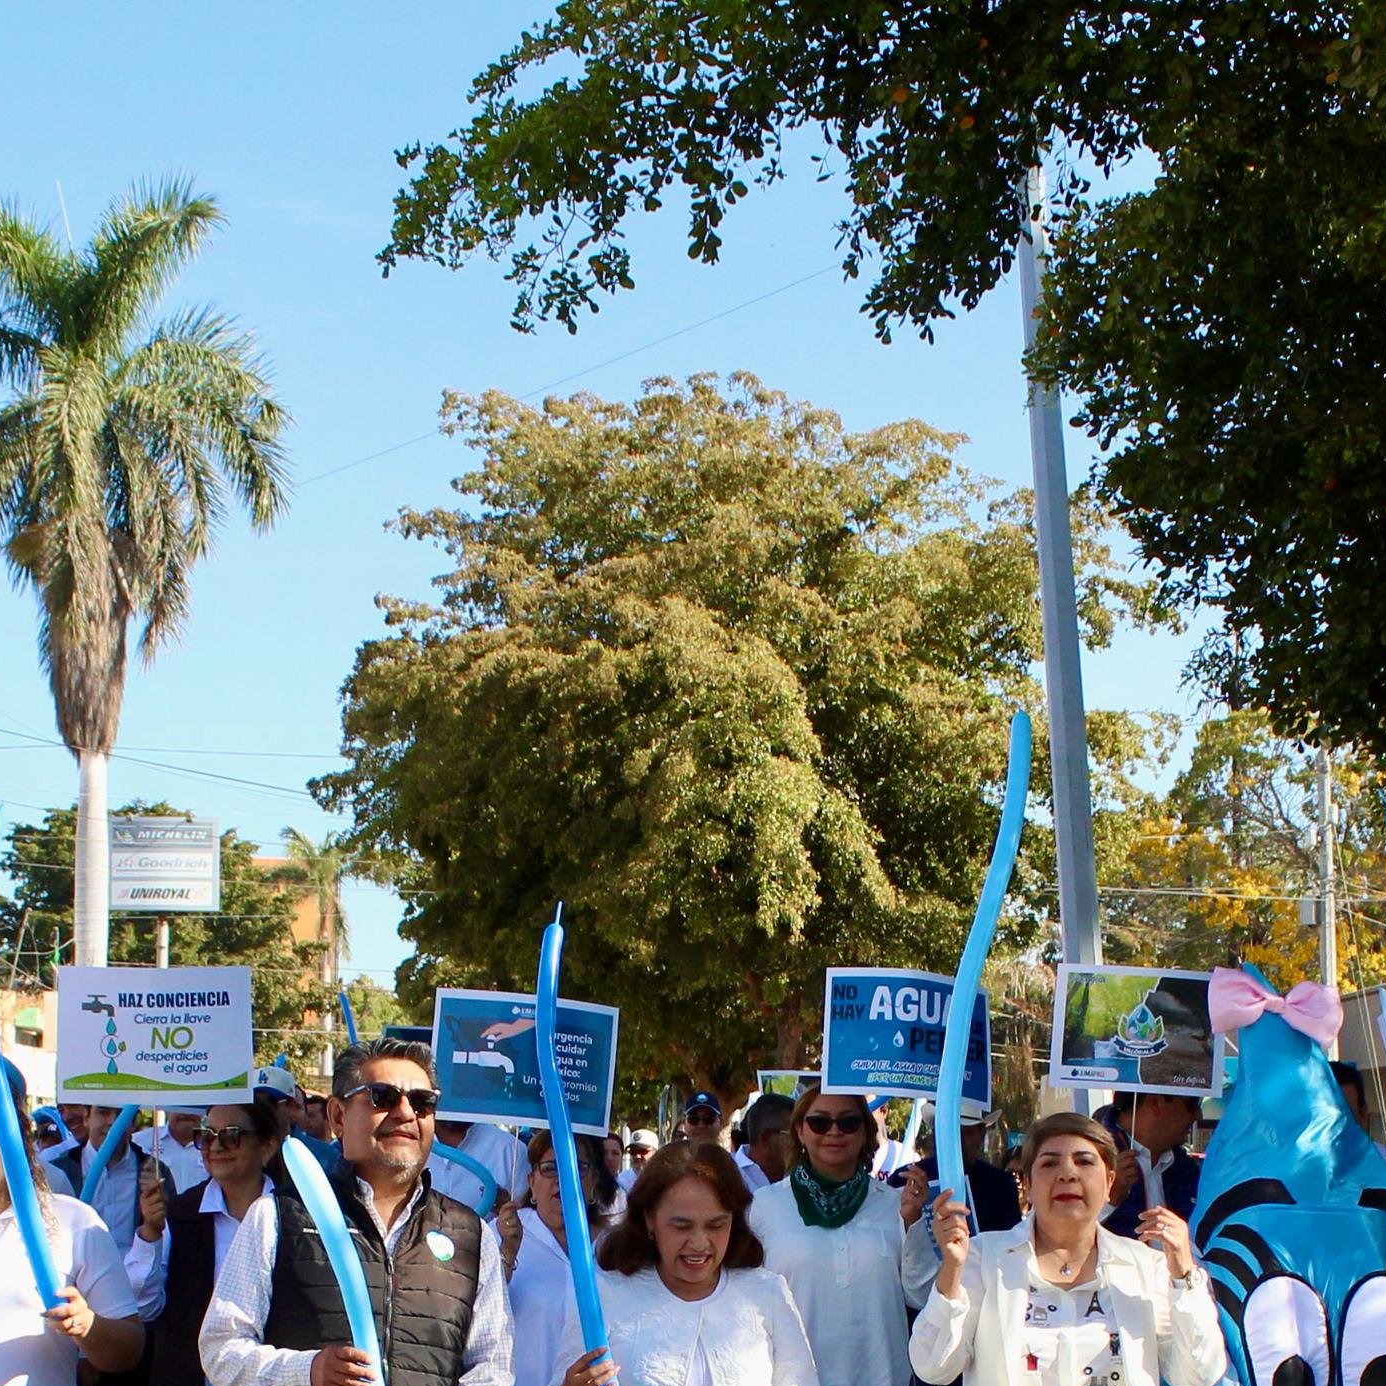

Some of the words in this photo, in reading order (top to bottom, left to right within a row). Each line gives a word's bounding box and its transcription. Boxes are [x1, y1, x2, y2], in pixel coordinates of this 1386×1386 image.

[137, 830, 208, 840] MICHELIN
[129, 887, 192, 900] UNIROYAL
[833, 984, 858, 1000] NO
[117, 992, 144, 1009] HAZ
[146, 990, 231, 1009] CONCIENCIA
[832, 1003, 866, 1021] HAY
[133, 1013, 168, 1025] Cierra
[170, 1013, 182, 1025] la
[183, 1013, 212, 1025] llave
[150, 1026, 195, 1050] NO
[135, 1050, 209, 1064] desperdicies
[556, 1056, 574, 1069] gua
[575, 1058, 589, 1068] en
[163, 1062, 175, 1074] el
[176, 1064, 208, 1076] agua
[558, 1067, 581, 1079] xico:
[522, 1075, 537, 1085] Un
